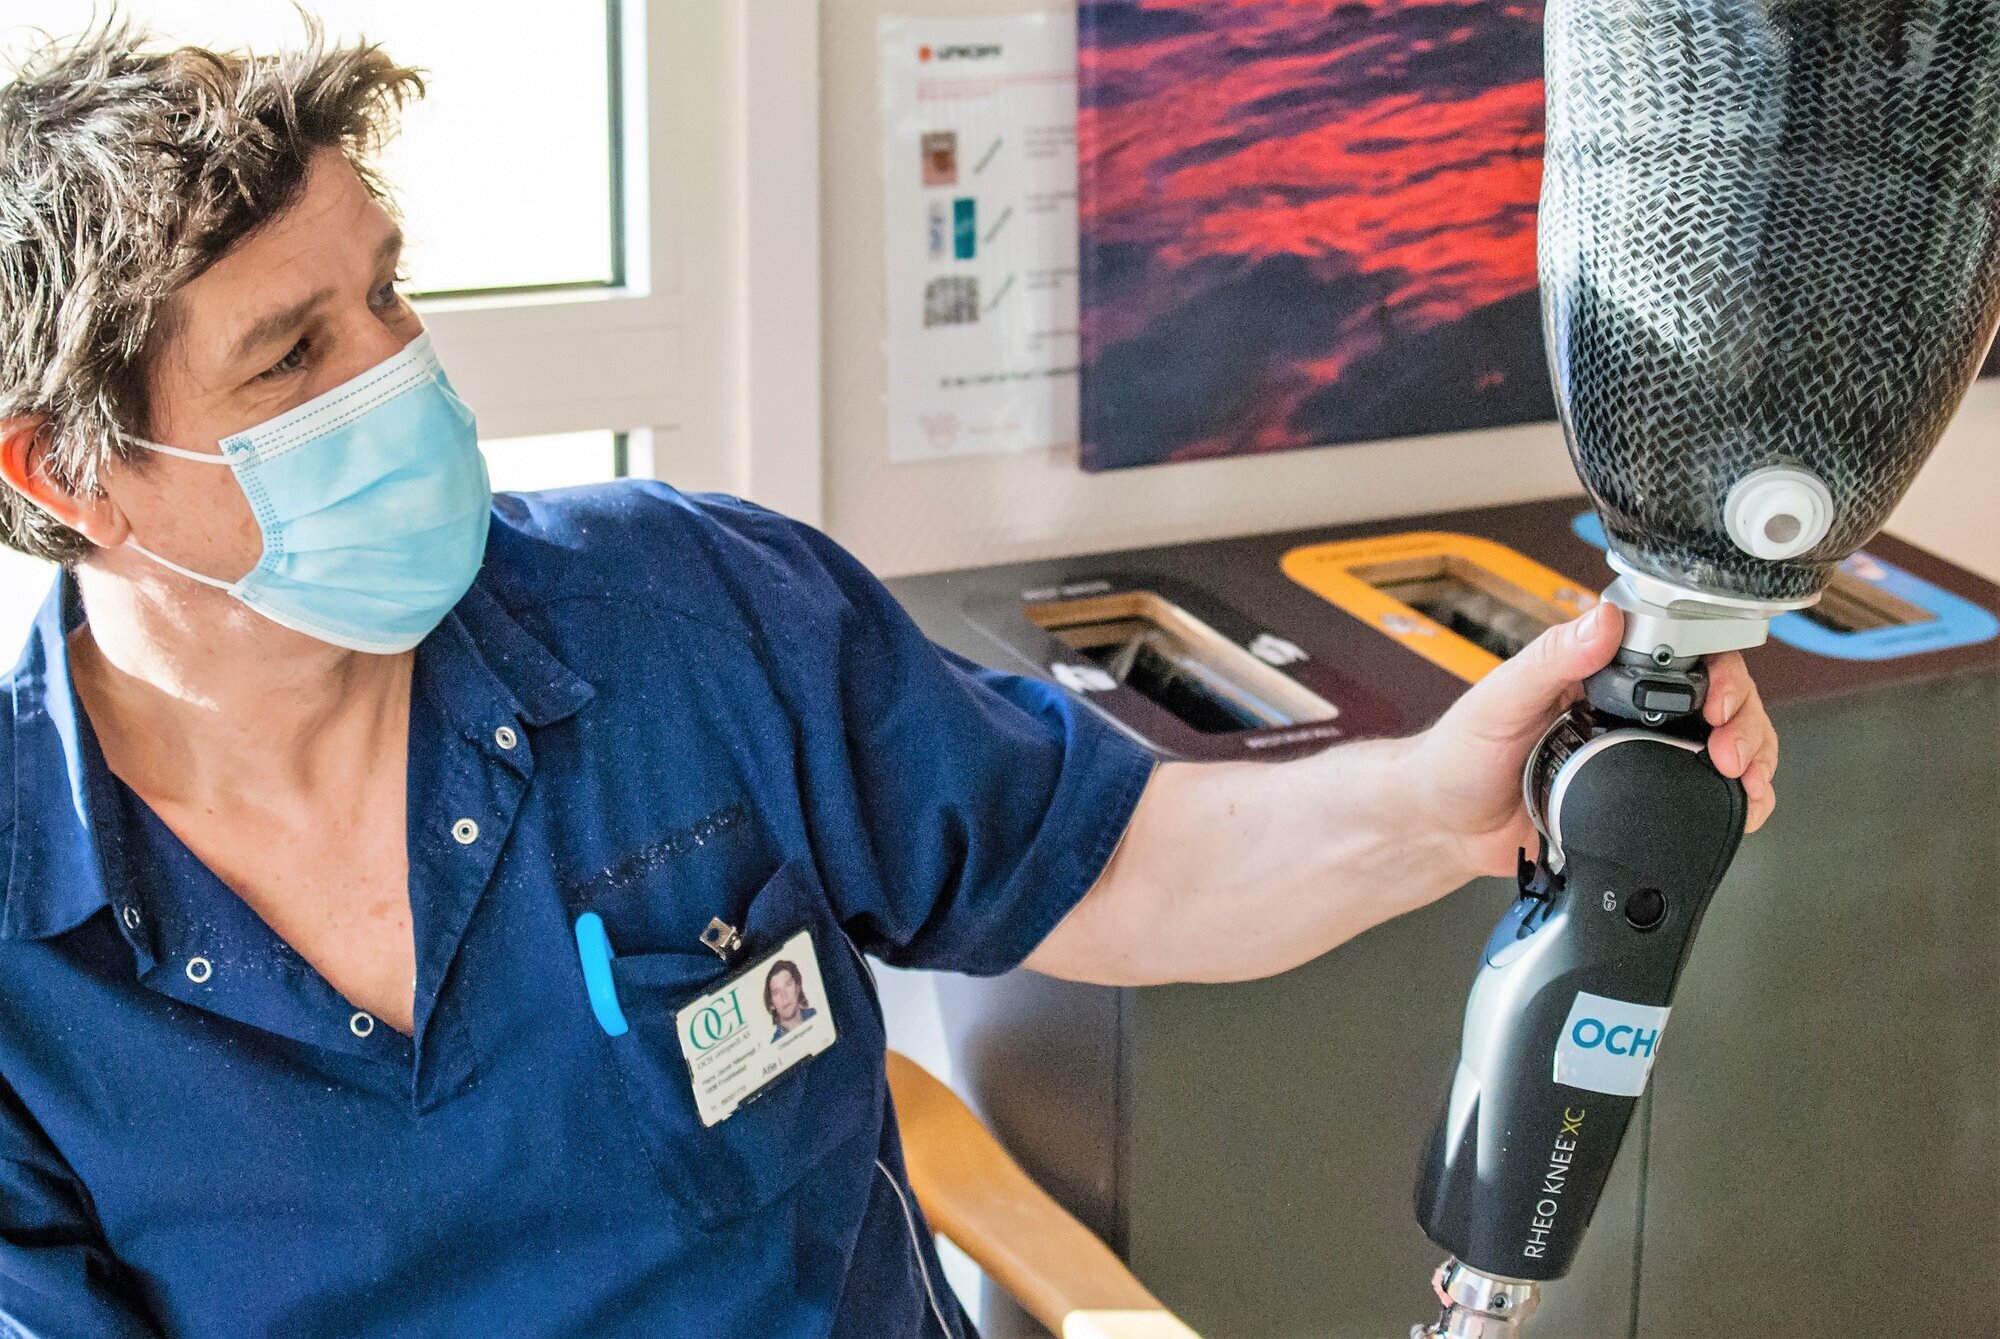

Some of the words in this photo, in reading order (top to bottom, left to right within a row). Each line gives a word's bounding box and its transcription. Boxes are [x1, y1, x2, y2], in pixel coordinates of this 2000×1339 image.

[689, 988, 747, 1050] OCH
[1572, 1018, 1658, 1058] OCH
[1523, 1199, 1558, 1259] RHEO
[1542, 1138, 1577, 1194] KNEE
[1560, 1107, 1586, 1136] XC
